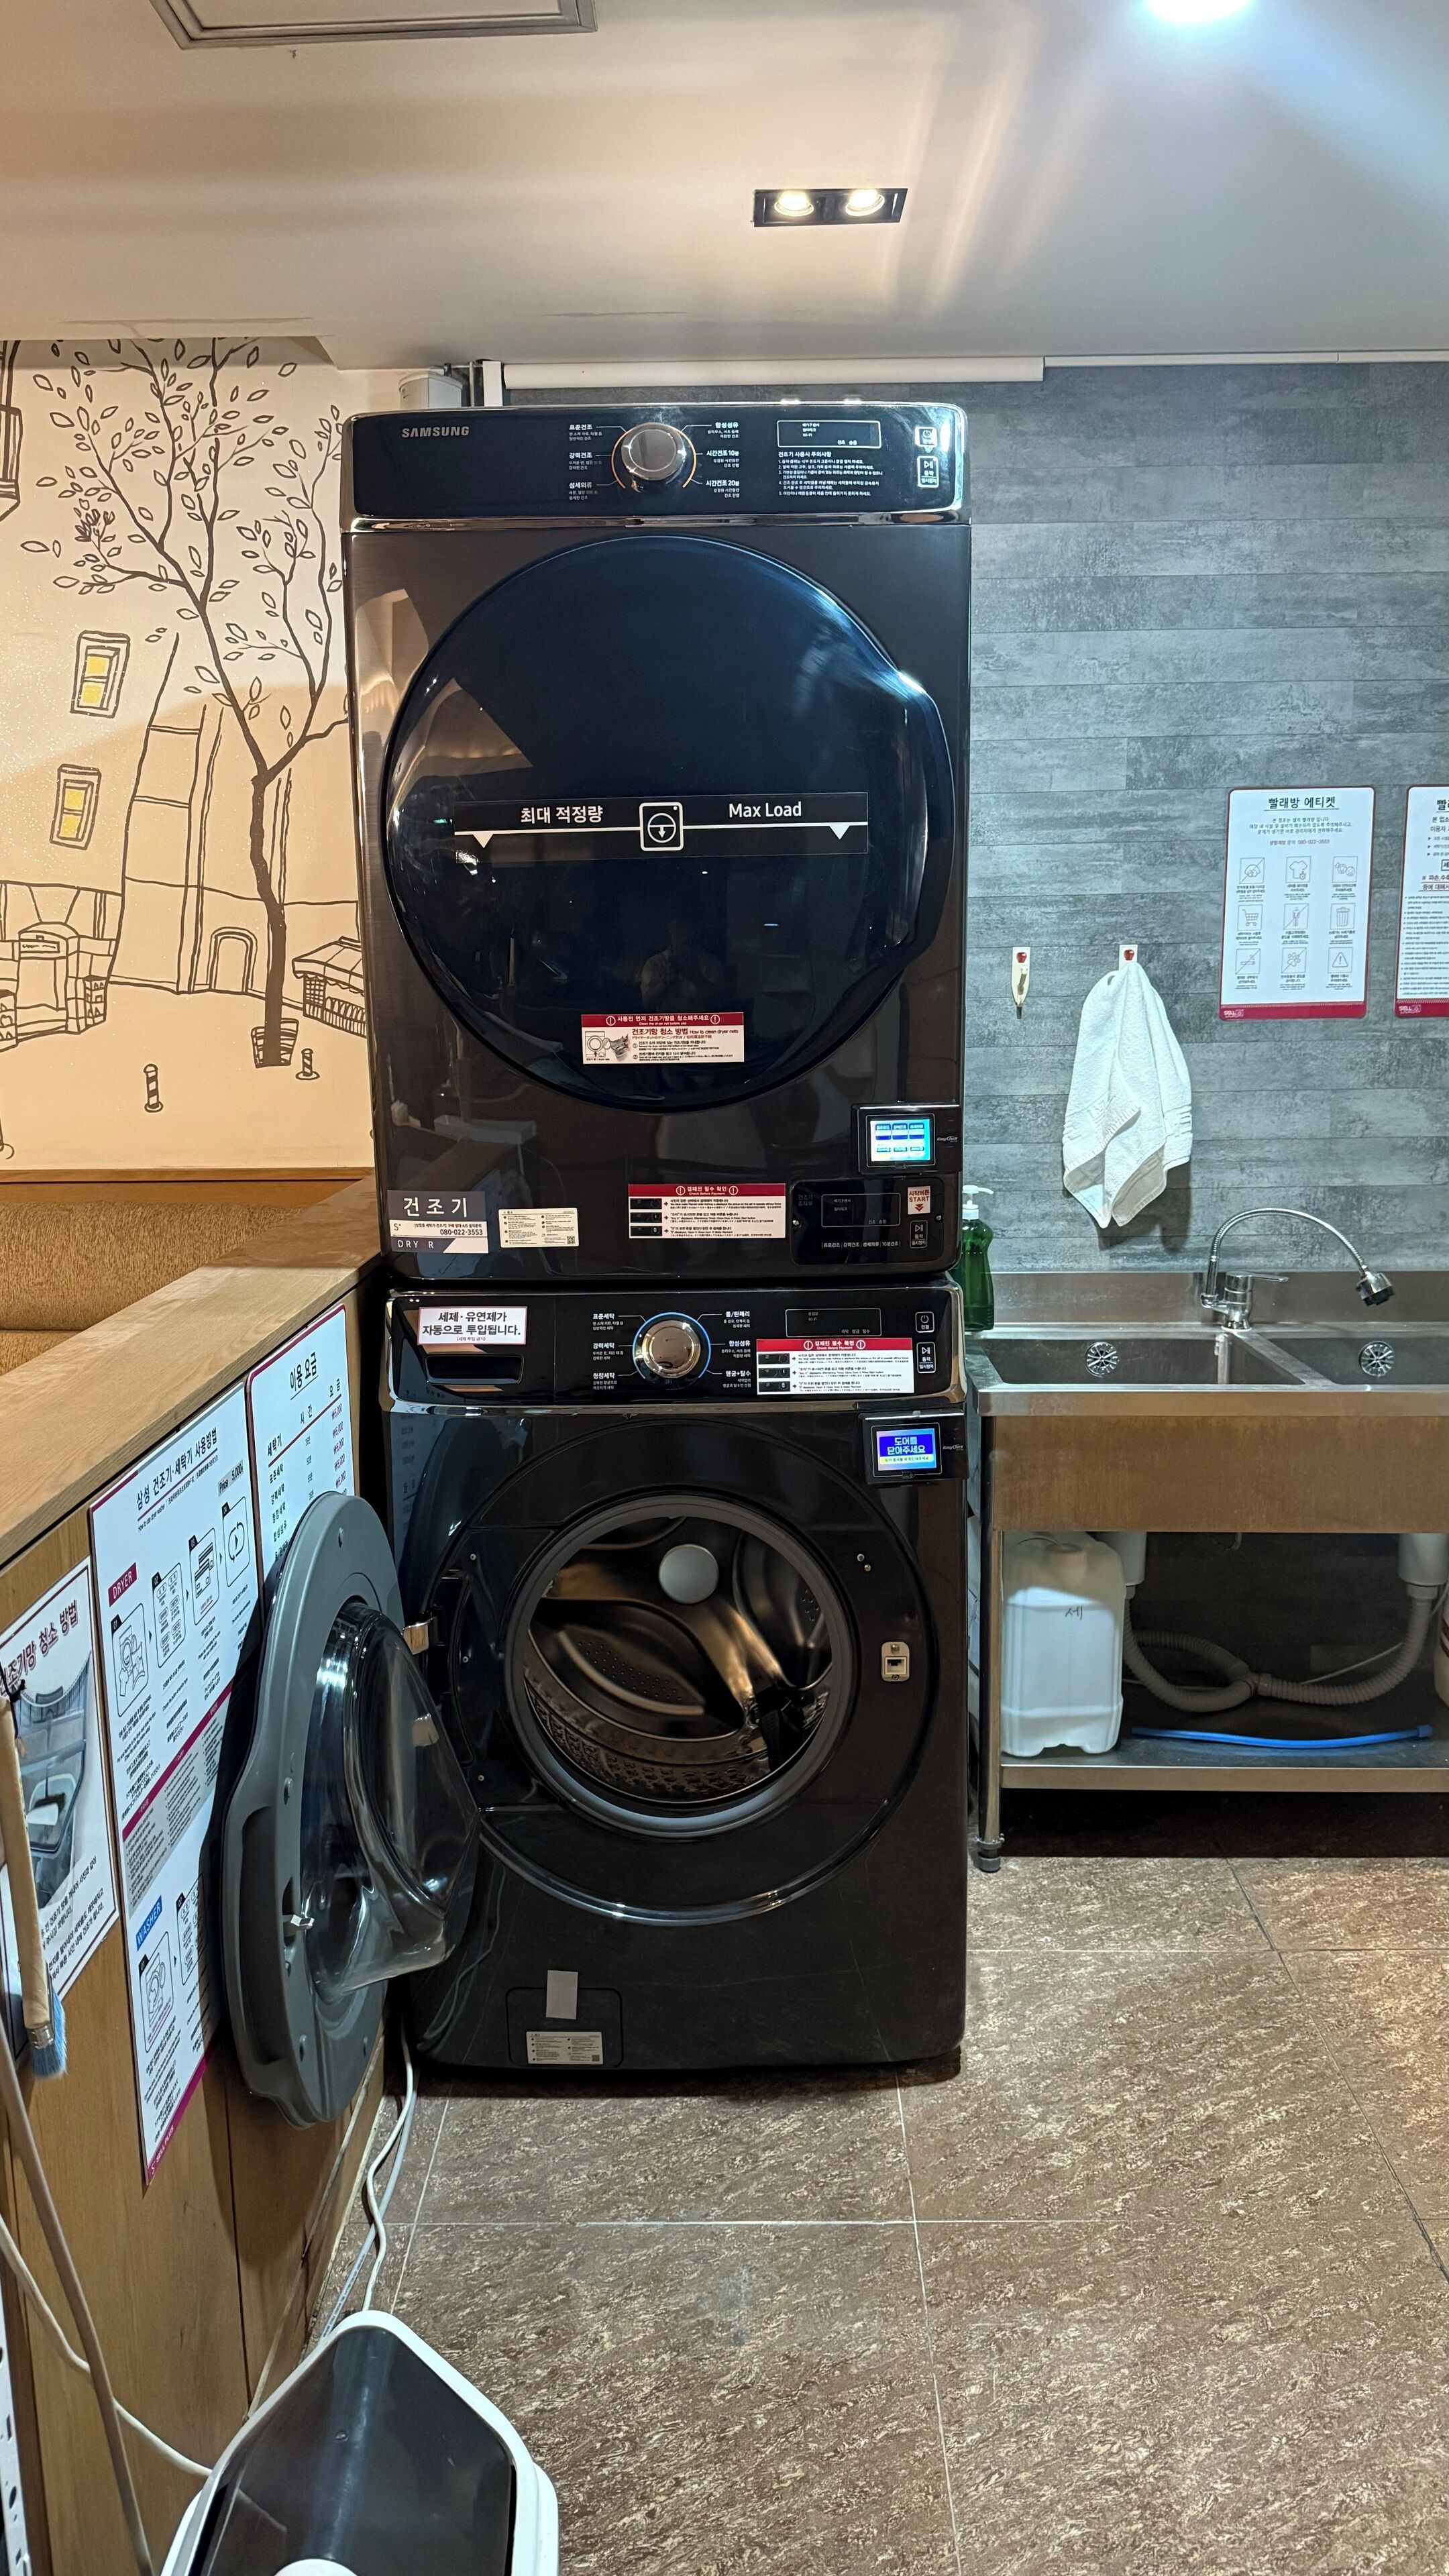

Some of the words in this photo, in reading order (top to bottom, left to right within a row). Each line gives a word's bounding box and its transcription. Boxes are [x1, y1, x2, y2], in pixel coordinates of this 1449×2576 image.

[402, 426, 470, 438] SAMSUNG
[1268, 797, 1300, 809] 빨래방
[1304, 796, 1336, 808] 에티켓
[521, 808, 551, 824] 최대
[555, 806, 603, 824] 적정량
[729, 803, 761, 818] Max
[765, 801, 802, 818] Load
[466, 1311, 507, 1322] 유연제가
[423, 1325, 463, 1336] 자동으로
[466, 1324, 521, 1335] 투입됩니다.
[290, 1364, 303, 1391] 이용
[305, 1352, 317, 1379] 요금
[268, 1433, 282, 1456] 세탁기
[887, 1445, 926, 1455] 닫아주세요
[136, 1483, 150, 1511] 삼성
[153, 1448, 193, 1496] 건조기·세탁기
[195, 1427, 217, 1458] 사용방법
[219, 1479, 229, 1494] Price
[113, 1570, 133, 1599] DRYER
[154, 1575, 158, 1585] 02
[1065, 1606, 1083, 1621] 세
[39, 1622, 59, 1657] 청소
[59, 1599, 78, 1636] 방법
[113, 1619, 117, 1629] 01
[49, 1906, 61, 1925] 건조기
[58, 1906, 73, 1928] 바랍니다.
[137, 1902, 160, 1945] WASHER
[68, 1946, 75, 1959] 시간
[83, 1919, 93, 1935] 건조가
